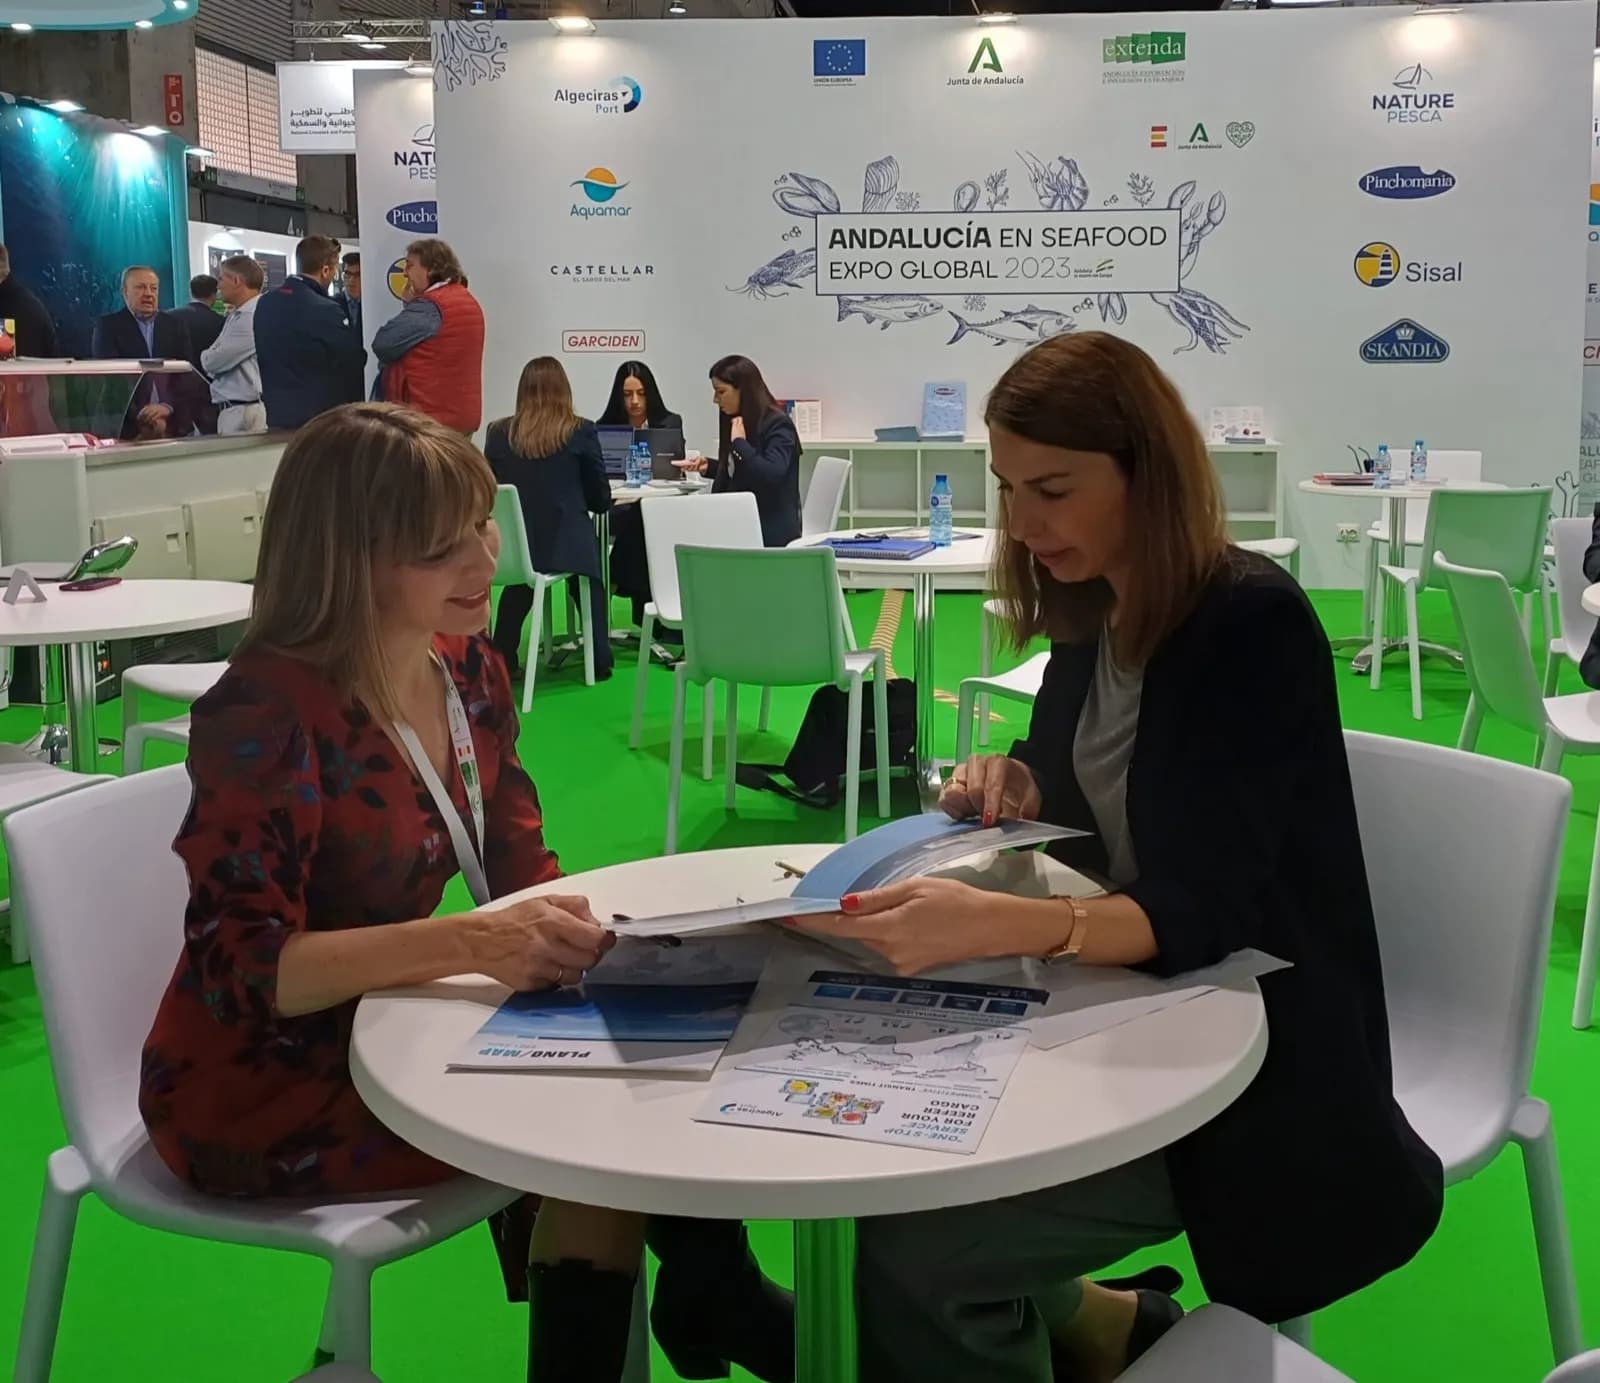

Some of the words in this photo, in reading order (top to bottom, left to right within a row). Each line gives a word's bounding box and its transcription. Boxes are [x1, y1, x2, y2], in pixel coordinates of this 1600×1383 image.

[1105, 36, 1182, 56] extenda
[946, 77, 970, 86] Junta
[972, 77, 982, 85] de
[983, 75, 1024, 85] Andalucía
[553, 89, 619, 103] Algeciras
[1373, 93, 1455, 110] NATURE
[595, 104, 619, 113] Port
[1387, 110, 1442, 123] PESCA
[1364, 173, 1453, 192] Pinchomania
[570, 203, 632, 221] Aquamar
[828, 220, 992, 249] ANDALUCÍA
[1000, 228, 1032, 248] EN
[1041, 226, 1167, 247] SEAFOOD
[550, 265, 655, 275] CASTELLAR
[829, 260, 893, 280] EXPO
[900, 259, 998, 279] GLOBAL
[1005, 256, 1072, 279] 2023
[1405, 261, 1462, 282] Sisal
[567, 335, 640, 347] GARCIDEN
[1365, 341, 1442, 359] SKANDIA
[478, 1047, 591, 1059] PLANO/MAP
[923, 1106, 976, 1119] REEFER
[930, 1100, 980, 1112] CARGO
[901, 1112, 939, 1123] YOUR
[944, 1117, 973, 1128] FOR
